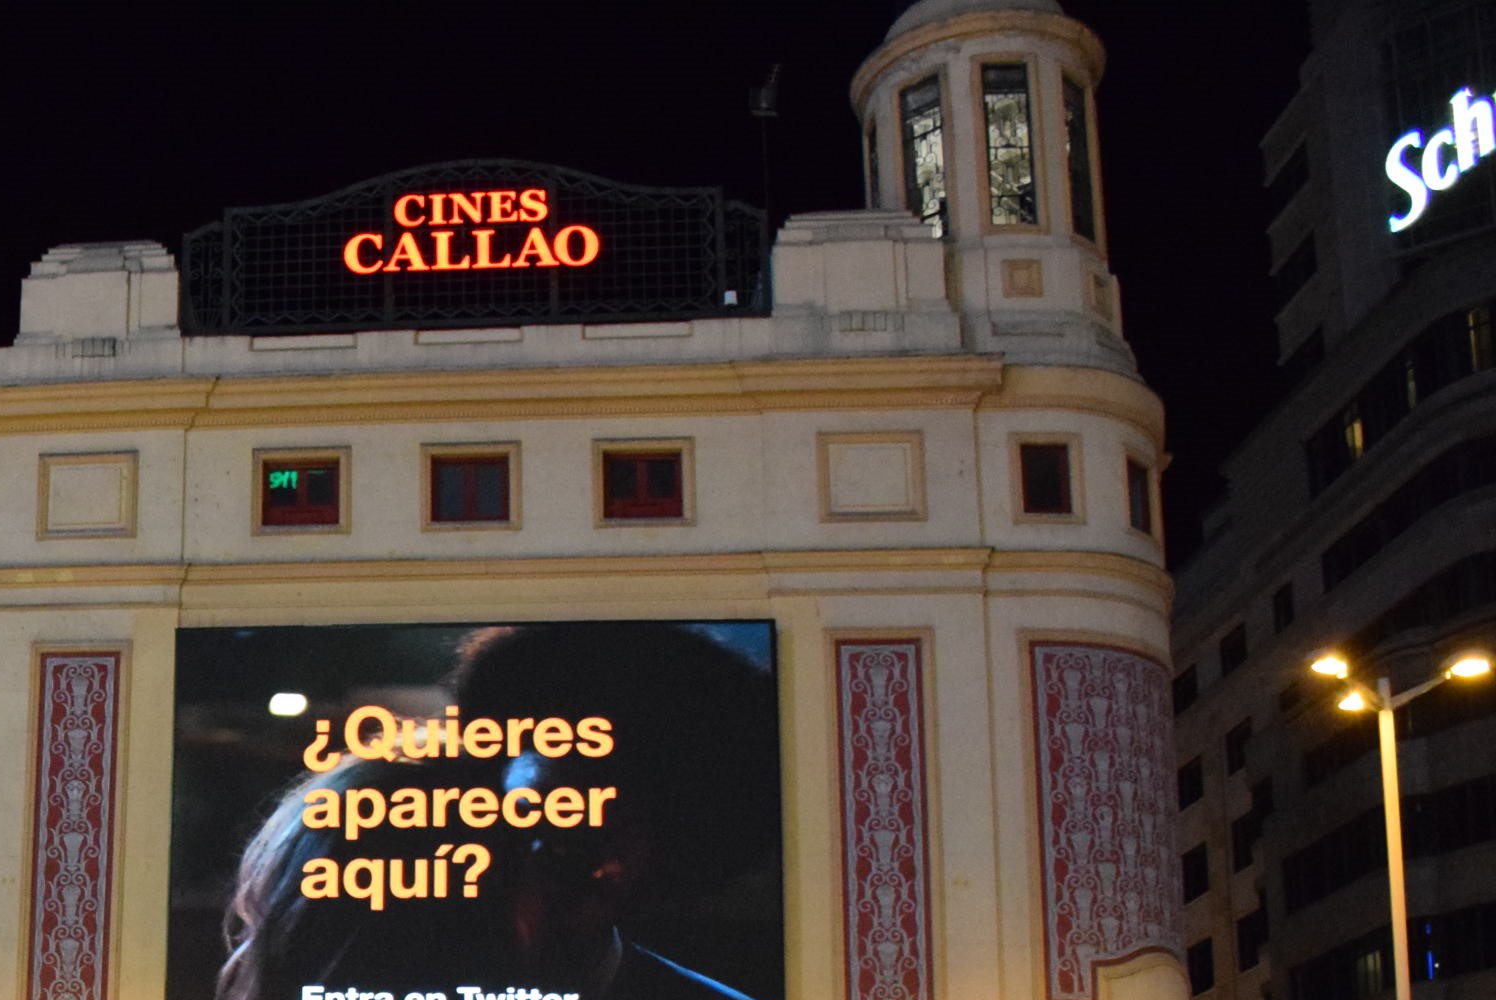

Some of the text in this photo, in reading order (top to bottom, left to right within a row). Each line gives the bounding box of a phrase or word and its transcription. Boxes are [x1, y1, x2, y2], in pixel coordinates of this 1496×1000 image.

[1385, 86, 1496, 233] Sch
[393, 188, 549, 228] CINES
[343, 225, 600, 275] CALLAO
[303, 705, 615, 773] ¿Quieres
[301, 786, 617, 841] aparecer
[300, 843, 492, 911] aquí?
